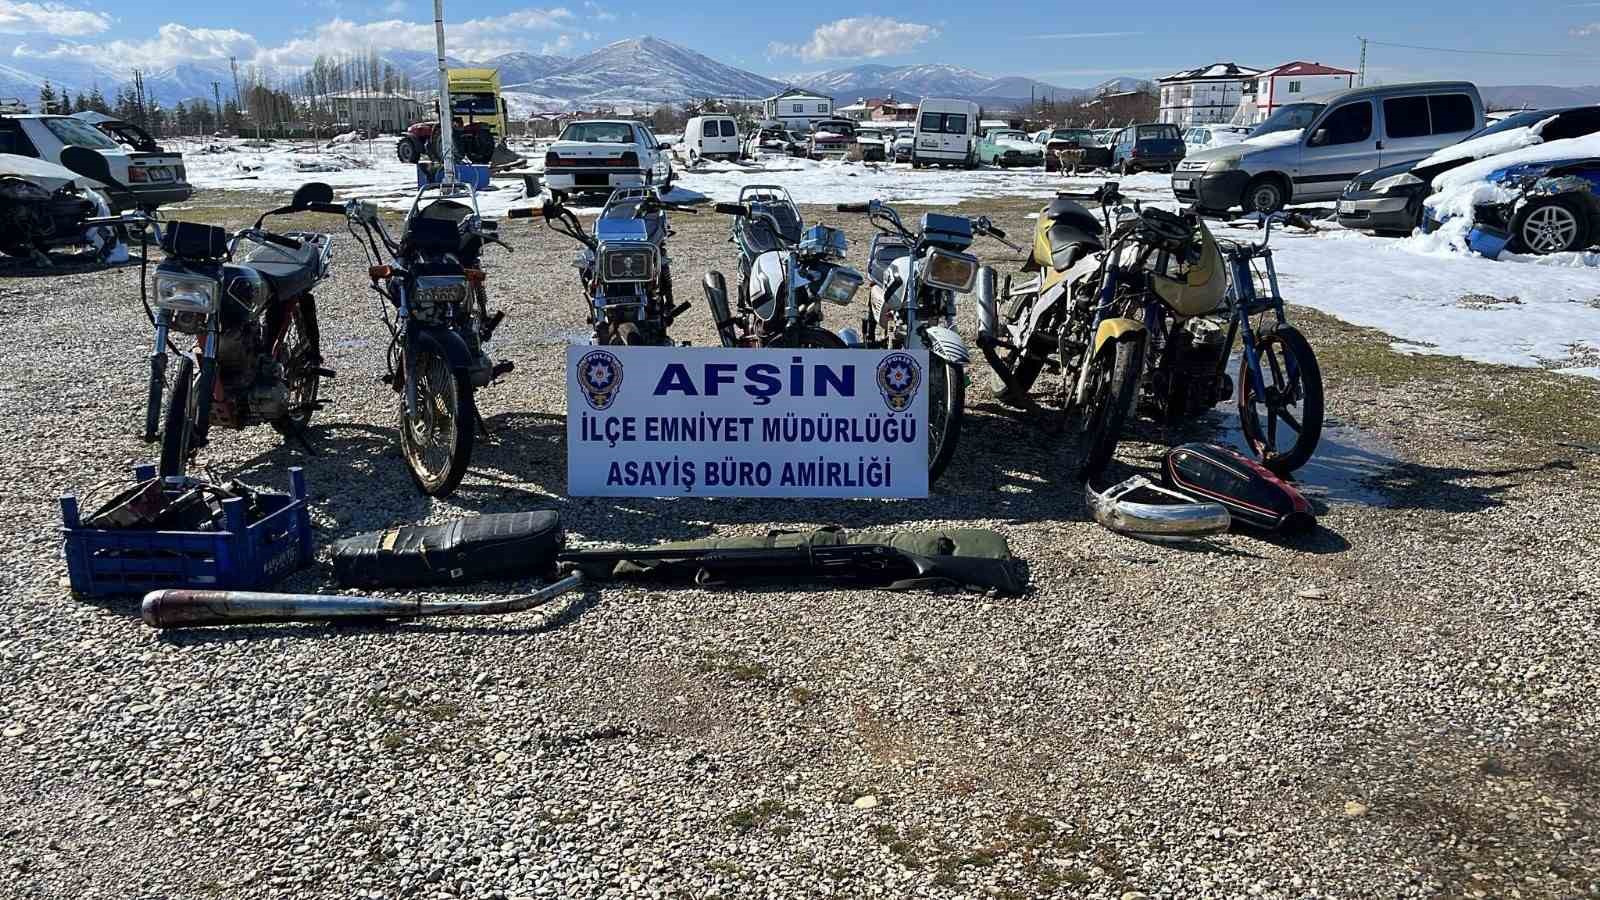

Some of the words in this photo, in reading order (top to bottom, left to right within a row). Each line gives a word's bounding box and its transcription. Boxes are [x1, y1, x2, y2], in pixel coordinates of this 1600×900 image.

[653, 356, 856, 405] AFŞİN
[581, 411, 637, 448] İLÇE
[645, 411, 755, 442] EMNİYET
[762, 412, 917, 443] MÜDÜRLÜĞÜ
[606, 455, 696, 492] ASAYİŞ
[704, 456, 772, 487] BÜRO
[780, 456, 892, 487] AMİRLİĞİ
